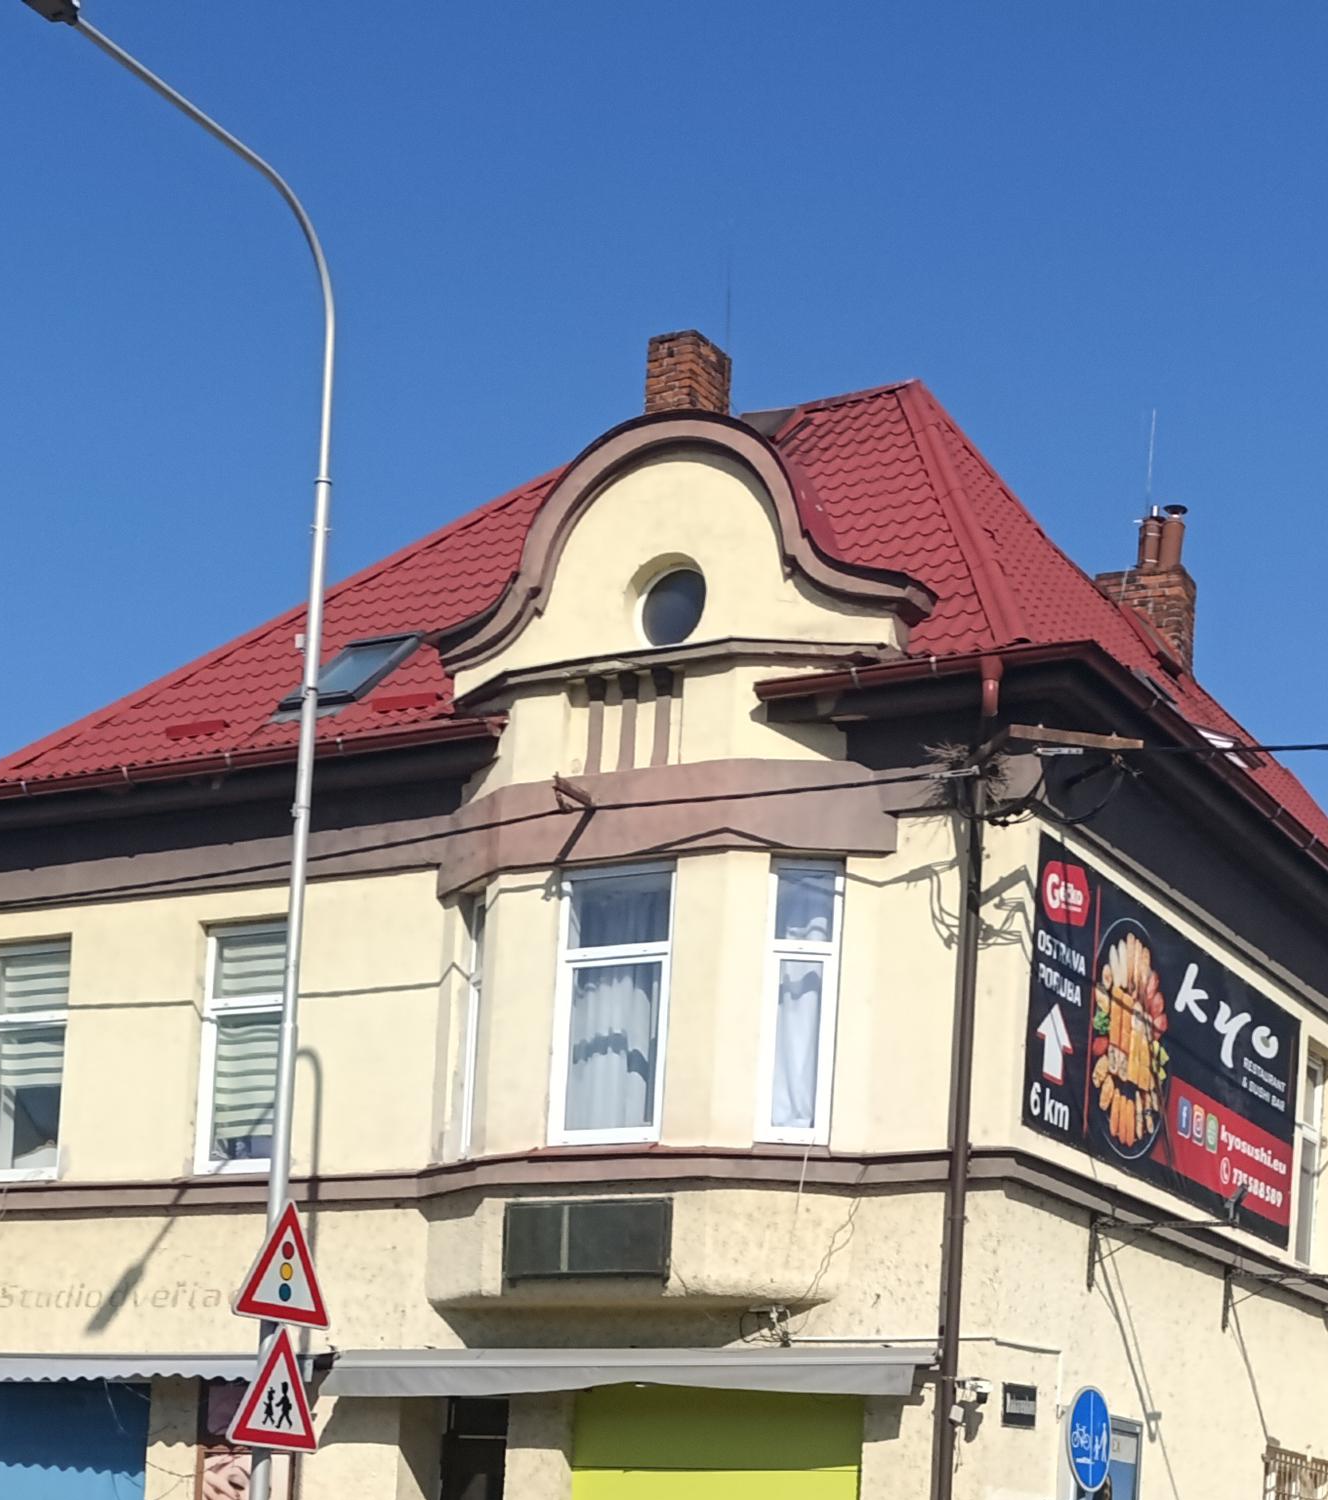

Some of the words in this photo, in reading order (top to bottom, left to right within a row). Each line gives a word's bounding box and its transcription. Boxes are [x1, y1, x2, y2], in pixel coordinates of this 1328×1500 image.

[1037, 929, 1086, 976] OSTRAVA
[1037, 962, 1082, 1007] PORUBA
[1174, 962, 1279, 1069] kyo
[1243, 1057, 1286, 1093] RESTAURANT
[1030, 1082, 1041, 1117] 6
[1043, 1087, 1070, 1131] km
[1220, 1124, 1287, 1175] kyosushi.eu
